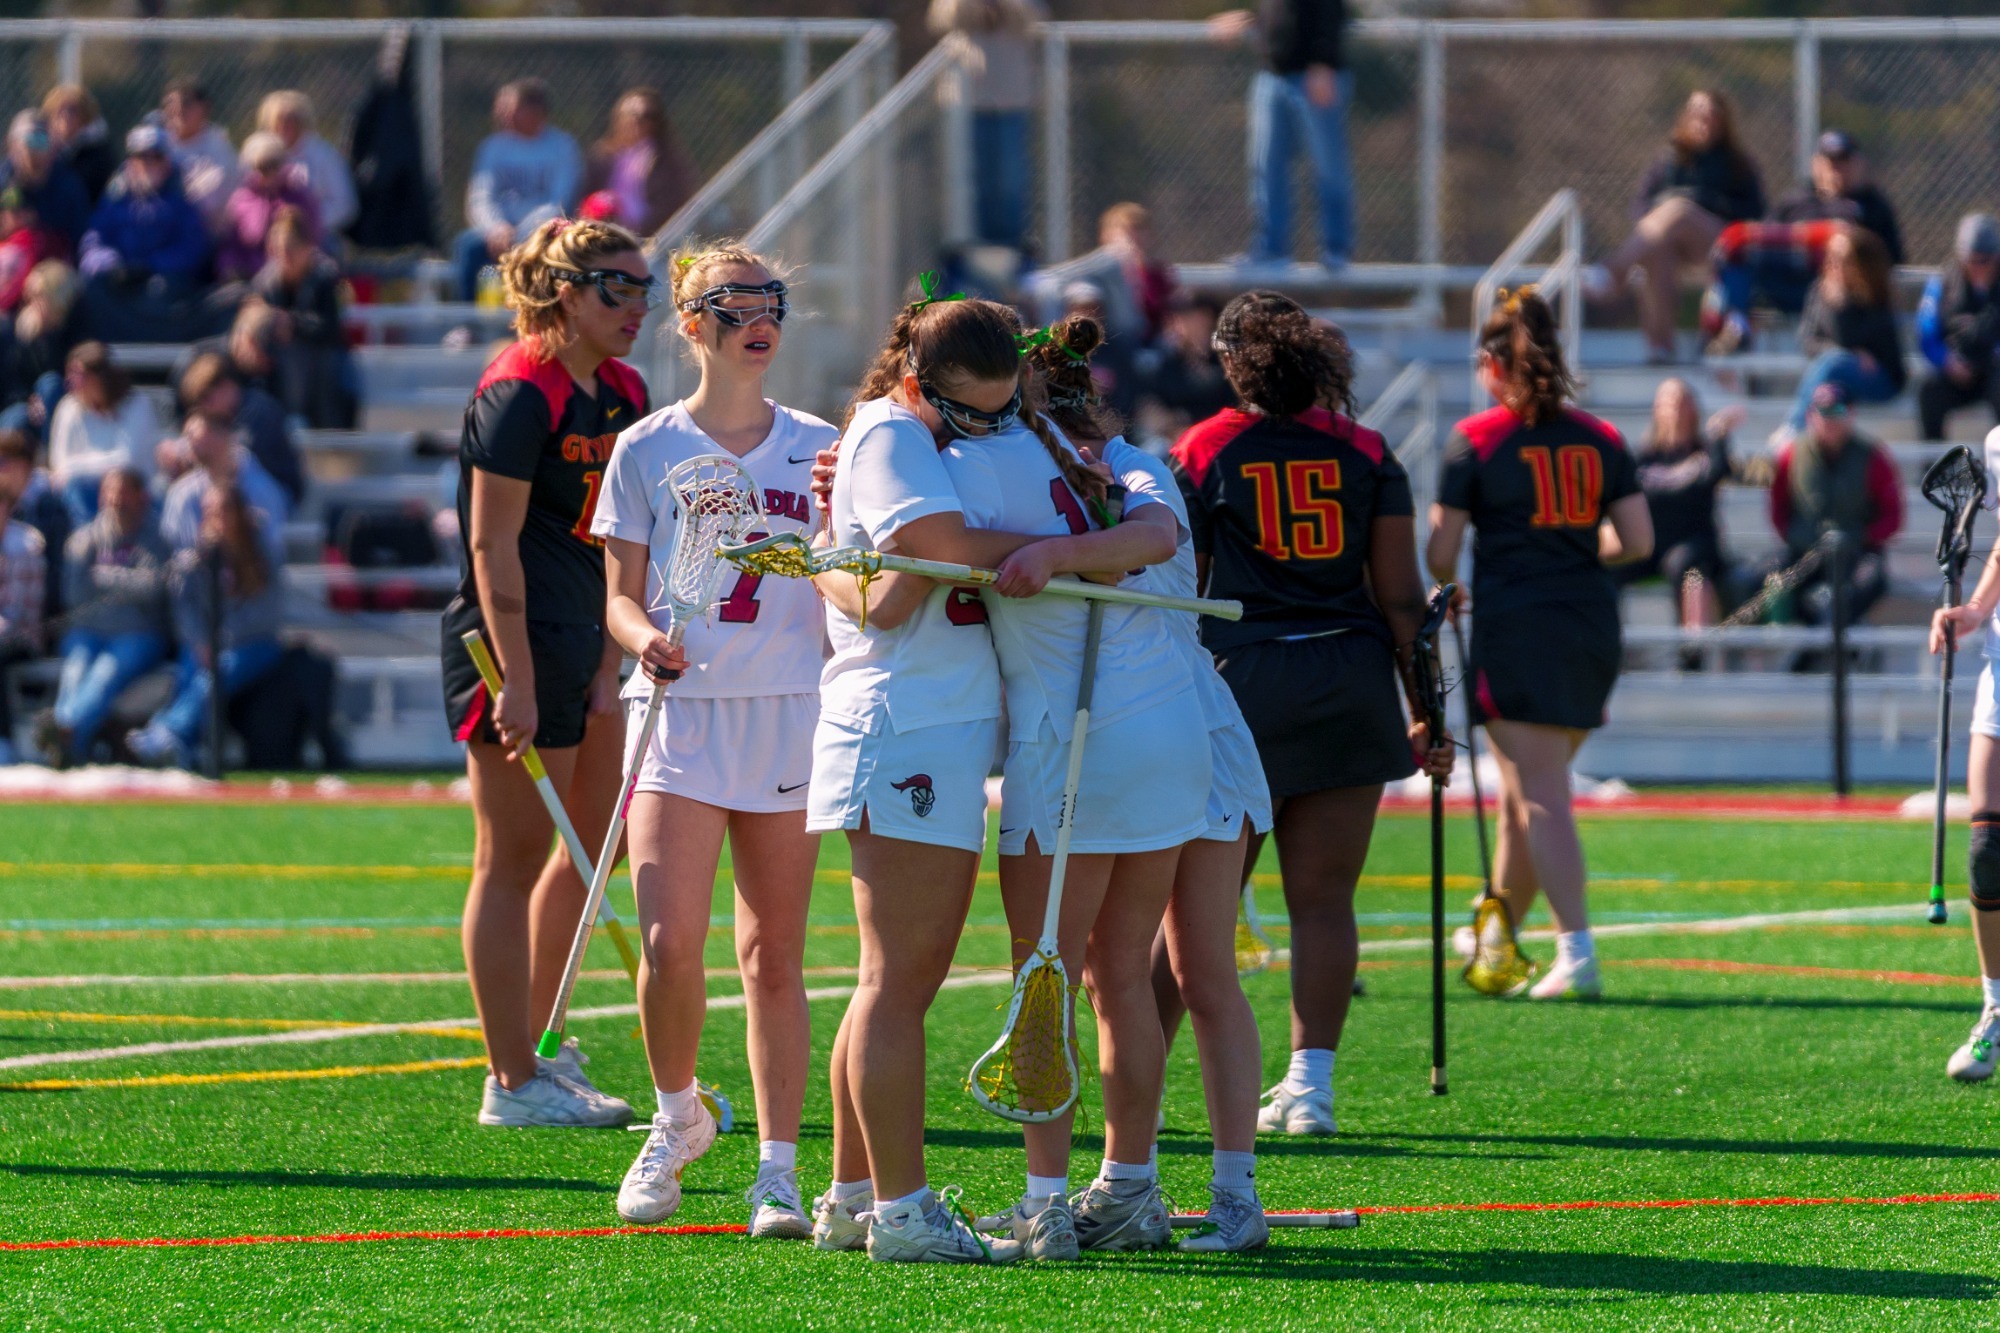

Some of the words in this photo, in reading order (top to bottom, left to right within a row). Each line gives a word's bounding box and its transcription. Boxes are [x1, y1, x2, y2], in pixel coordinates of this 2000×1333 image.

[570, 471, 606, 546] 1
[1241, 459, 1344, 561] 15
[1519, 445, 1604, 528] 10
